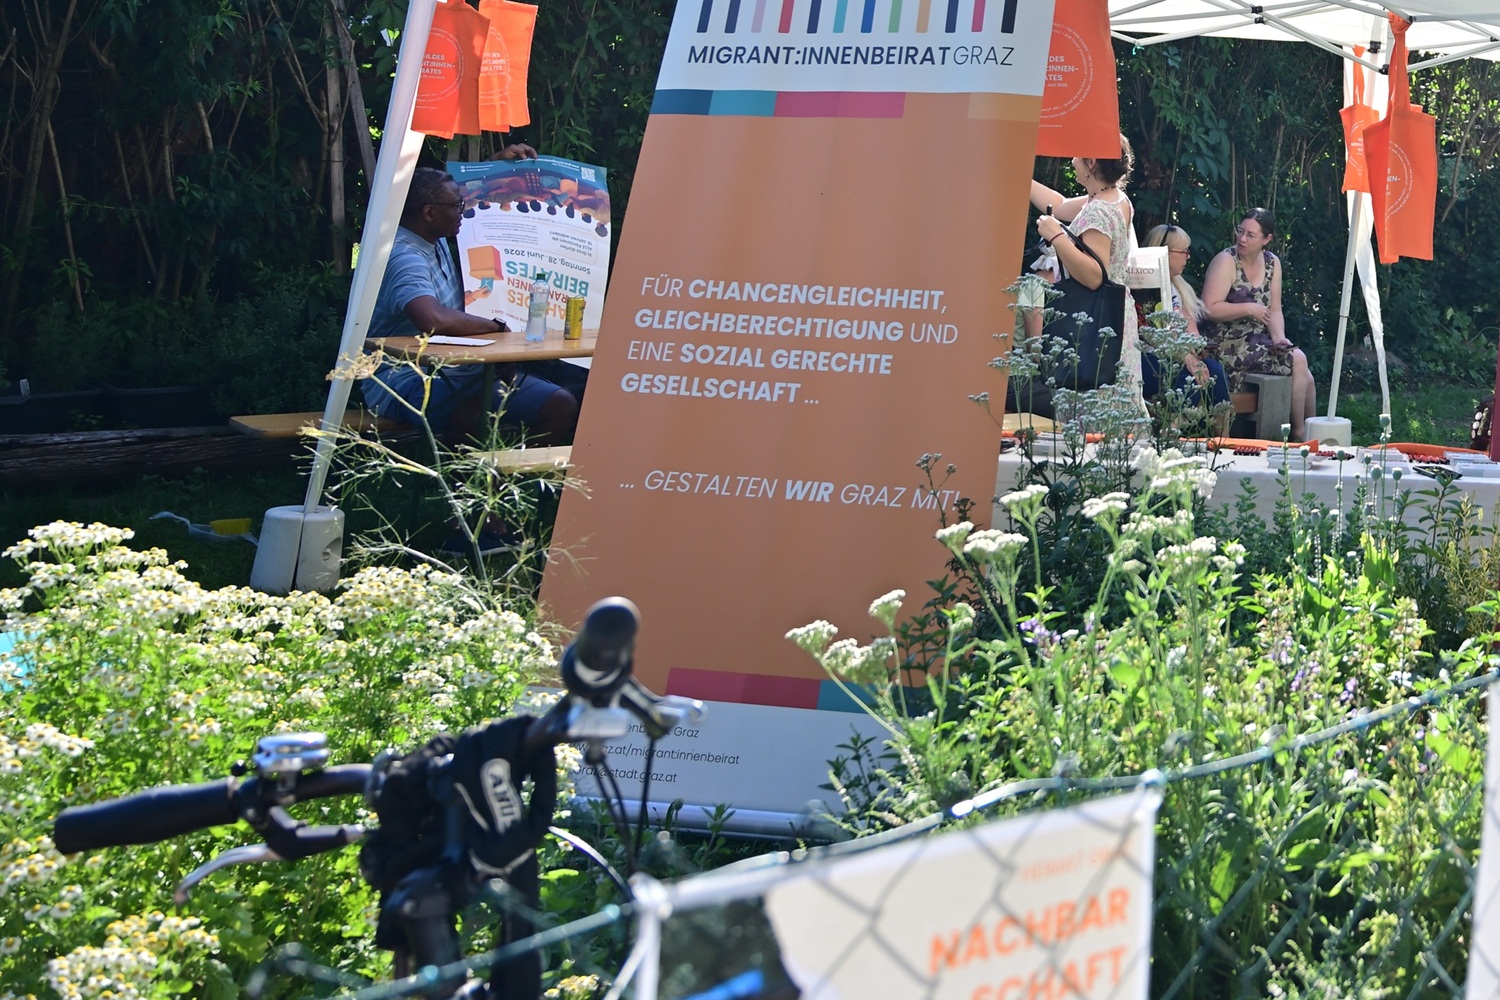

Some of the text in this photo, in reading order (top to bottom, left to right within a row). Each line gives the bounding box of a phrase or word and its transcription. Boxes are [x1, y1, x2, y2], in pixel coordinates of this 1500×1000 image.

[504, 248, 591, 274] Sonntag, 28. Juni 2026
[641, 274, 948, 314] FÜR CHANCENGLEICHHEIT,
[634, 308, 958, 344] GLEICHBERECHTIGUNG UND
[627, 340, 894, 375] EINE SOZIAL GERECHTE
[620, 372, 801, 403] GESELLSCHAFT
[644, 470, 778, 499] GESTALTEN
[785, 480, 835, 502] WIR
[840, 484, 907, 508] GRAZ
[674, 726, 700, 738] Graz
[929, 886, 1131, 976] NACHBAR
